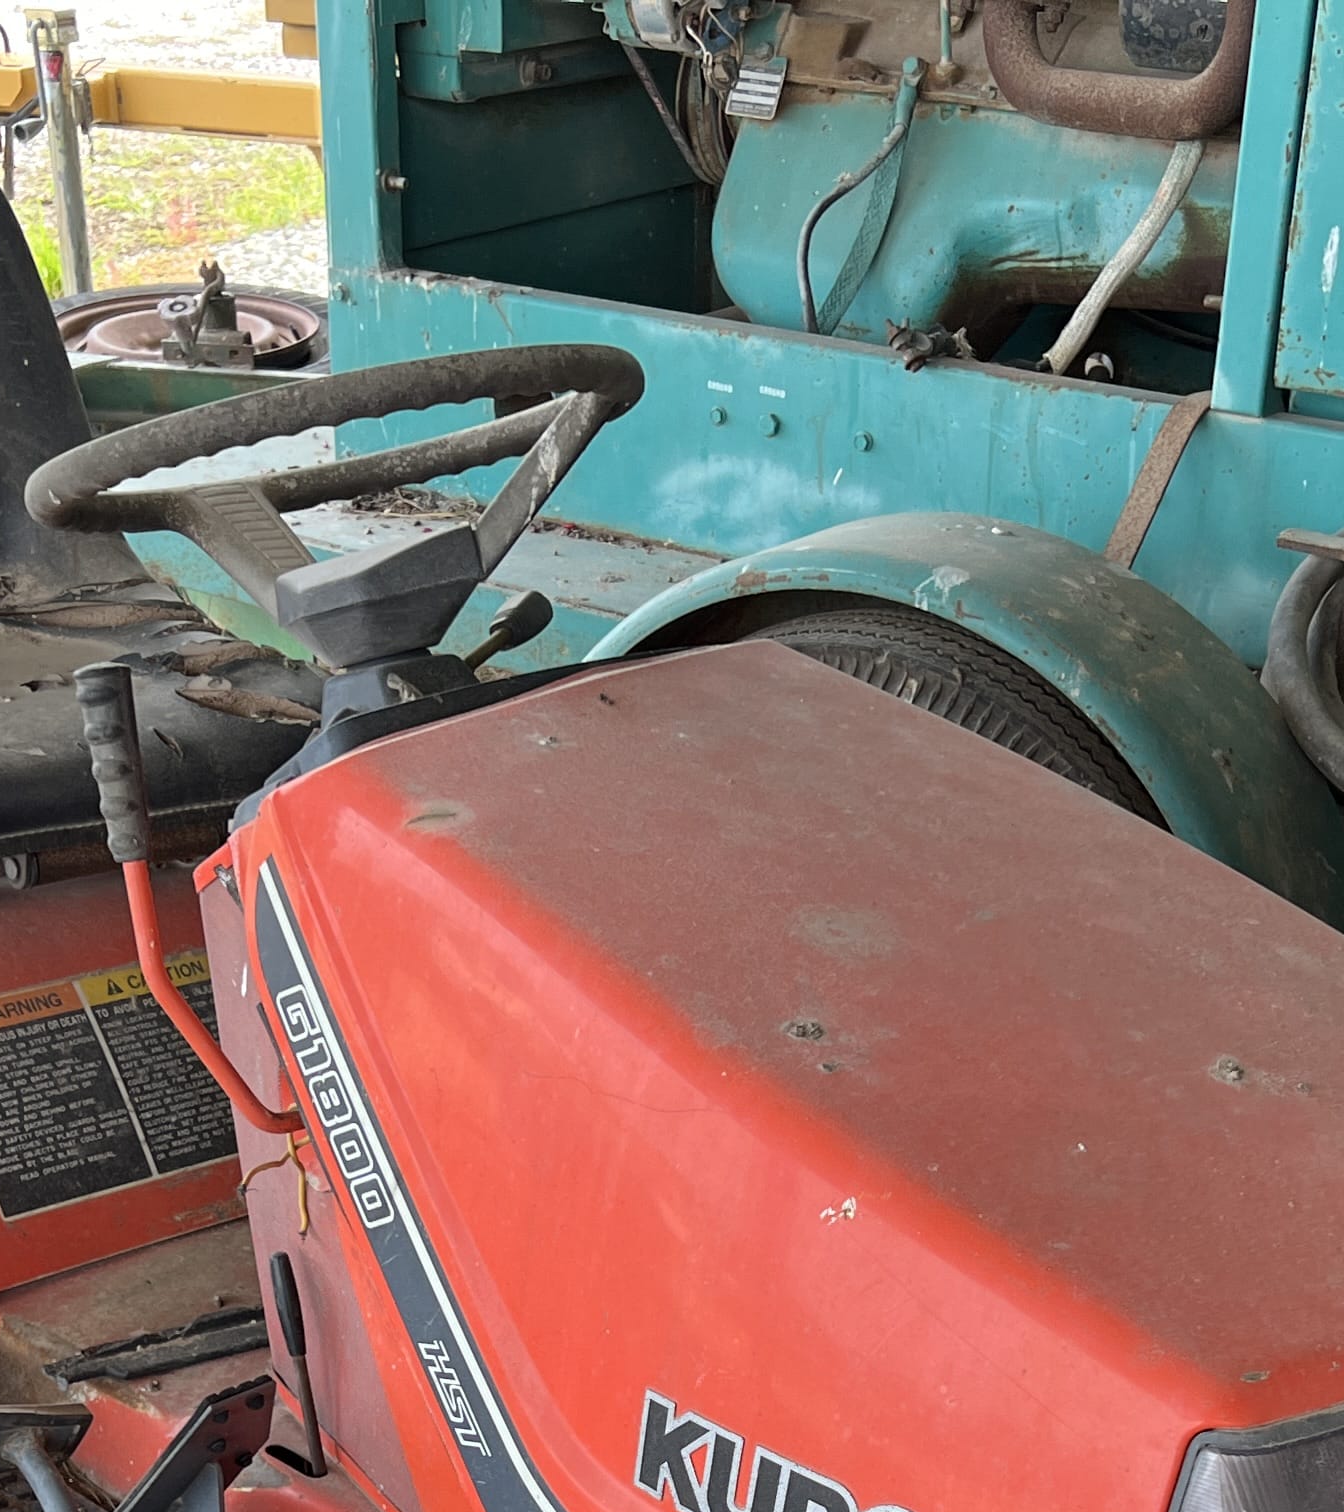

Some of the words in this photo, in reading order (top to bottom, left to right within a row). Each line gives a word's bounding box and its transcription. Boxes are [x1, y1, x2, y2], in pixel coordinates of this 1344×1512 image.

[95, 1008, 109, 1018] TO
[16, 1023, 45, 1036] INJURY
[47, 1020, 59, 1030] OR
[59, 1014, 86, 1027] DEATH
[28, 1035, 51, 1046] STEEP
[55, 1028, 82, 1040] SLOPES
[19, 1046, 47, 1057] SLOPES
[5, 1069, 28, 1079] STOPS
[31, 1063, 53, 1072] GOING
[13, 1078, 26, 1086] AND
[30, 1073, 48, 1082] BACK
[74, 1060, 101, 1071] SLOWLY
[20, 1081, 54, 1093] CHILDREN
[22, 1093, 42, 1102] WHEN
[45, 1084, 78, 1097] CHILDREN
[274, 983, 396, 1229] G1800
[23, 1112, 37, 1121] AND
[5, 1132, 32, 1144] SAFETY
[56, 1129, 79, 1140] PLACE
[23, 1145, 55, 1158] OBJECTS
[58, 1139, 75, 1148] THAT
[80, 1132, 102, 1143] COULD
[418, 1338, 491, 1457] HST
